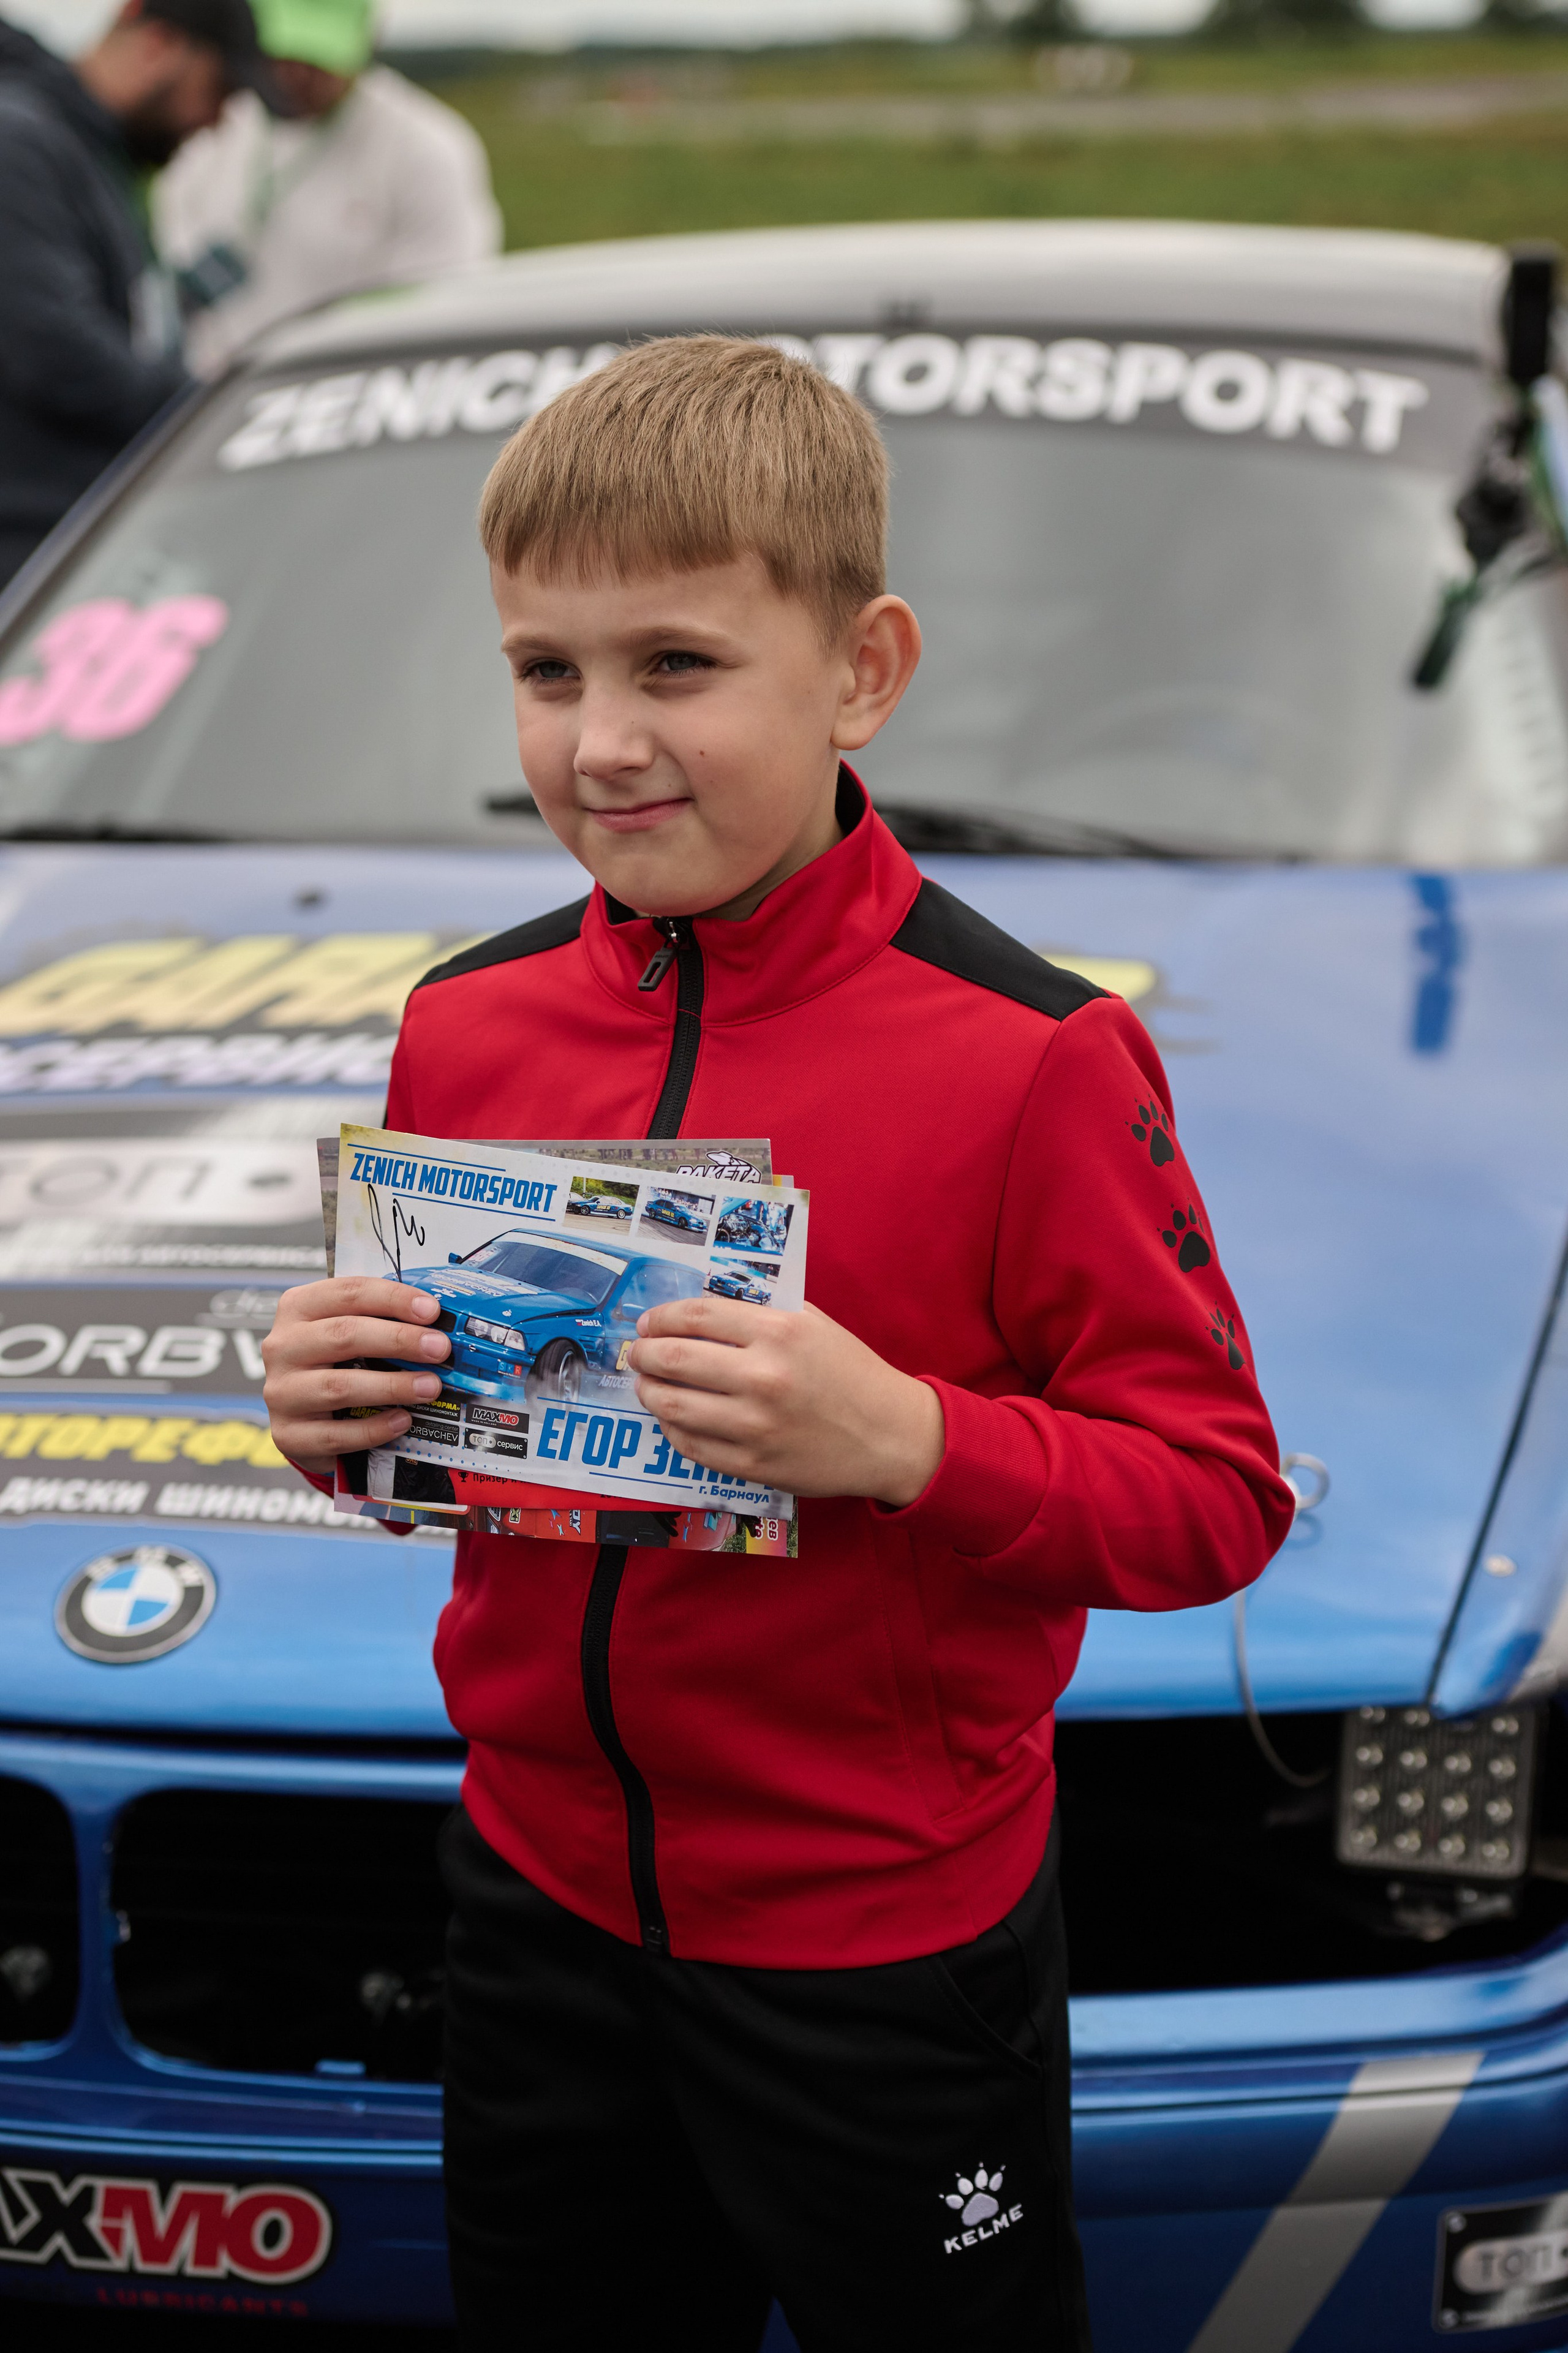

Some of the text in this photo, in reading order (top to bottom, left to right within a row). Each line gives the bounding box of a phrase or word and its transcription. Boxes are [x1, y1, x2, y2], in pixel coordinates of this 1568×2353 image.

[756, 333, 1428, 453] TORSPORT
[350, 1152, 558, 1212] ZENICH MOTORSPORT
[430, 1408, 458, 1417] ШИНОМОНТАЖ
[472, 1408, 519, 1426] MAXMO
[473, 1435, 523, 1451] ТОП сервис
[537, 1408, 643, 1469] ЕГОР
[473, 1473, 508, 1484] Призер
[0, 1476, 149, 1515] ДИСКИ
[699, 1485, 769, 1504] г. Барнаул
[944, 2203, 1024, 2254] KELME
